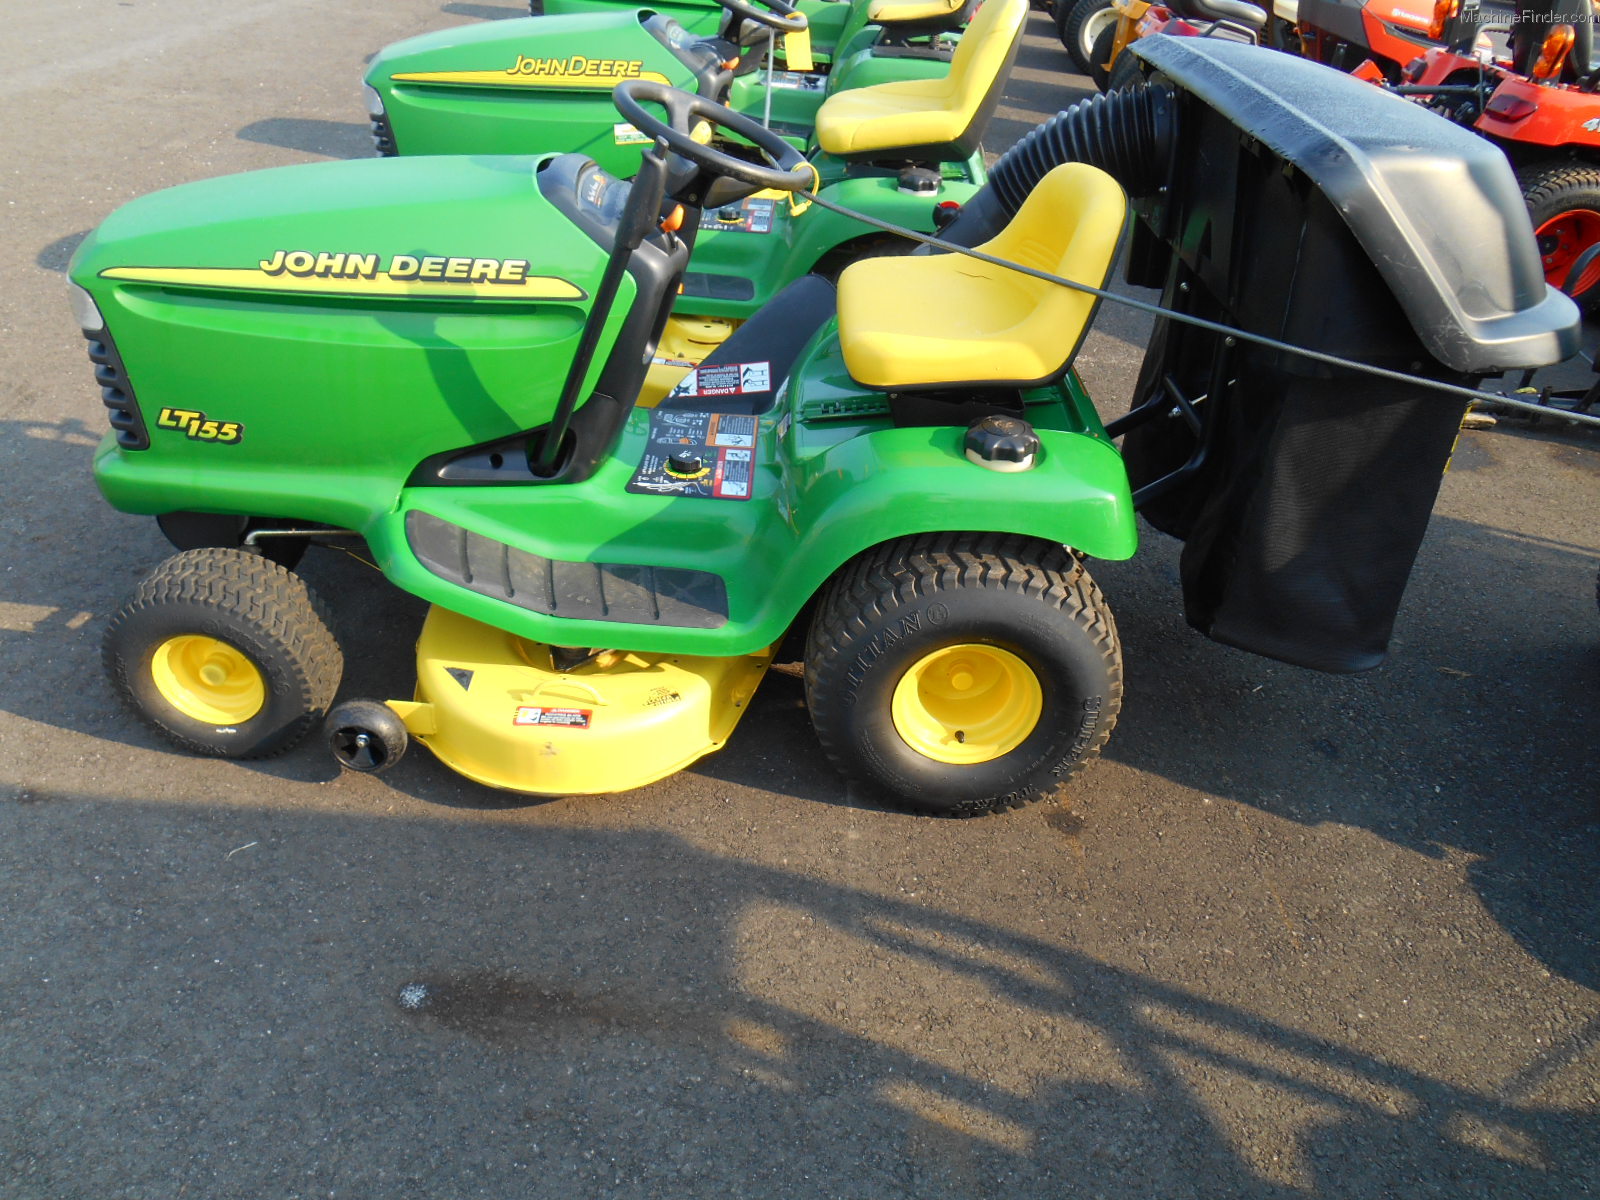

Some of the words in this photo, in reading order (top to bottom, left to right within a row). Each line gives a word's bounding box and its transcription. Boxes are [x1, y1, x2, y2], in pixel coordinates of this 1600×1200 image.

[506, 55, 568, 76] JOHN
[568, 55, 643, 77] DEERE
[258, 250, 379, 279] JOHN
[388, 255, 531, 284] DEERE
[157, 408, 241, 443] LT155
